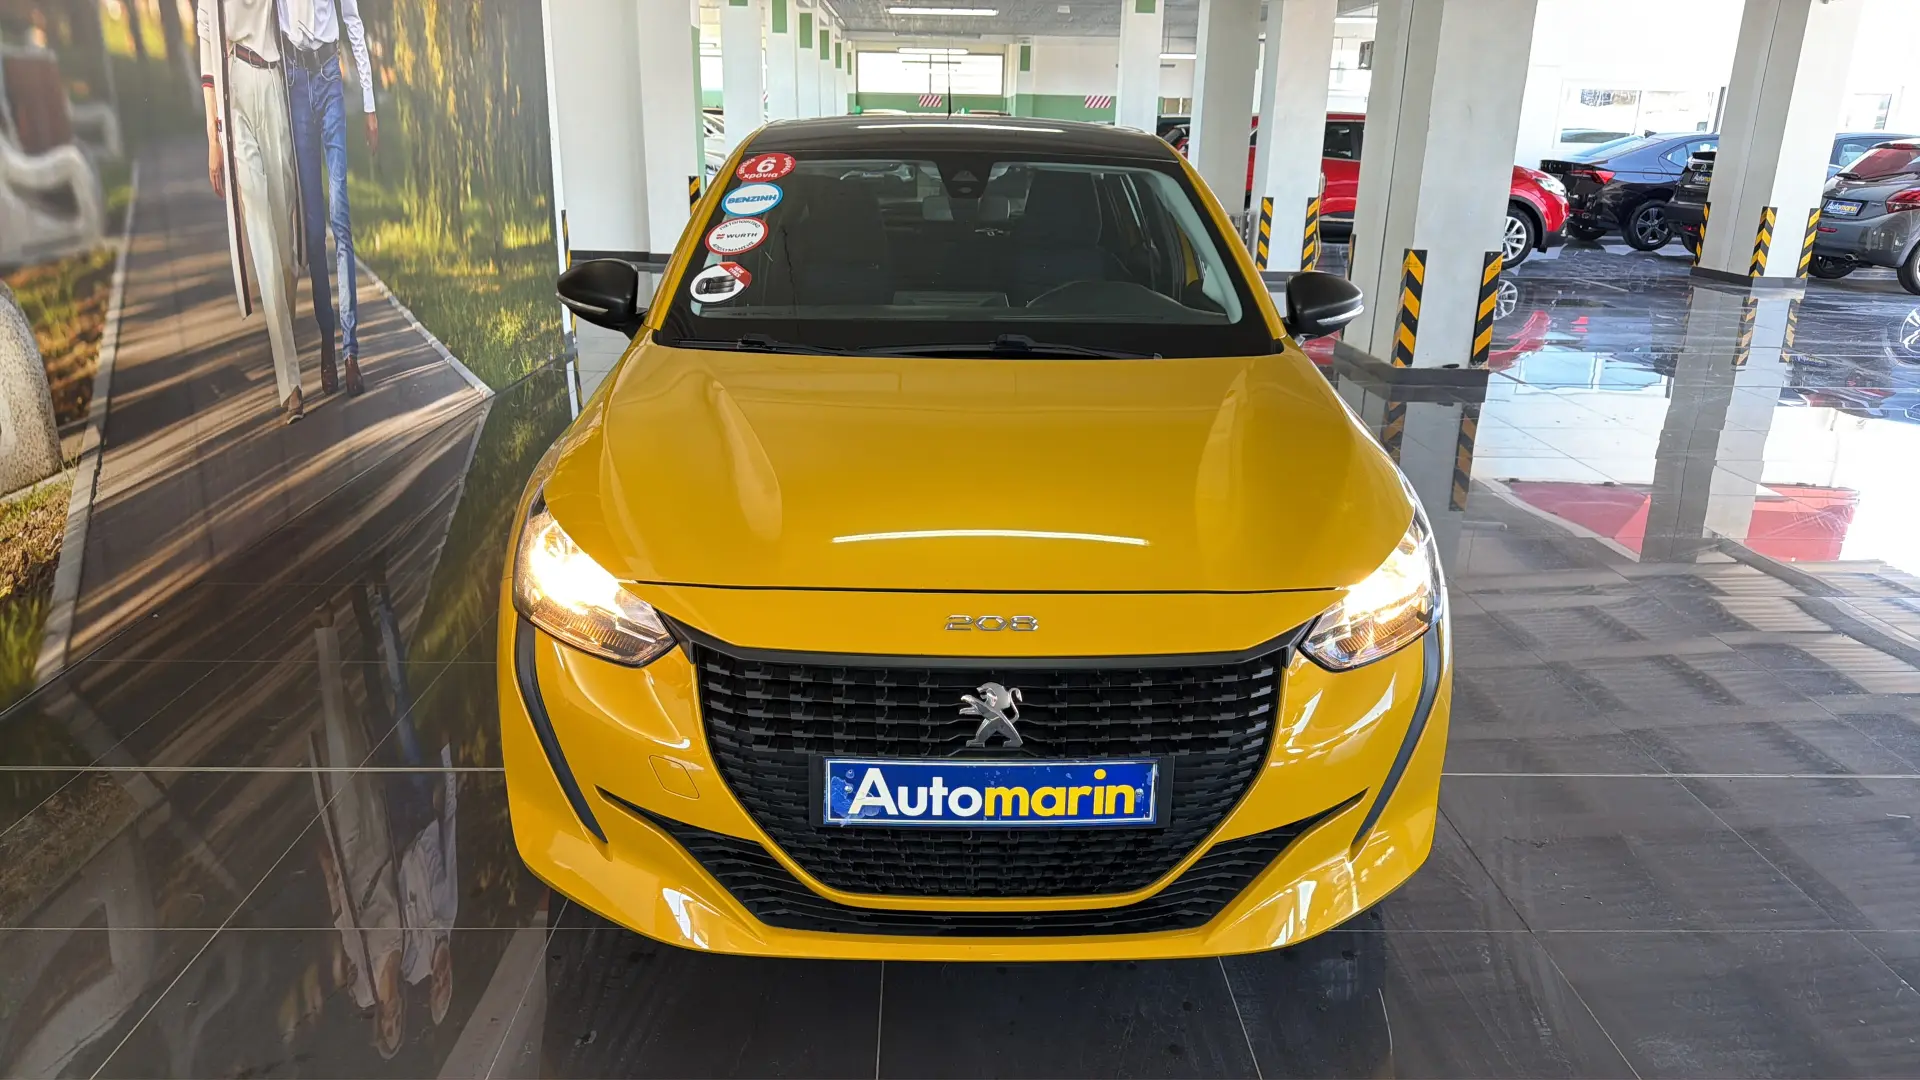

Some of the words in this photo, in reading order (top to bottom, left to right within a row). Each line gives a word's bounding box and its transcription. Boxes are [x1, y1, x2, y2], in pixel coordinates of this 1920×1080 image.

[756, 159, 777, 173] 6
[944, 614, 1039, 632] 208
[848, 767, 1135, 817] Automarin
